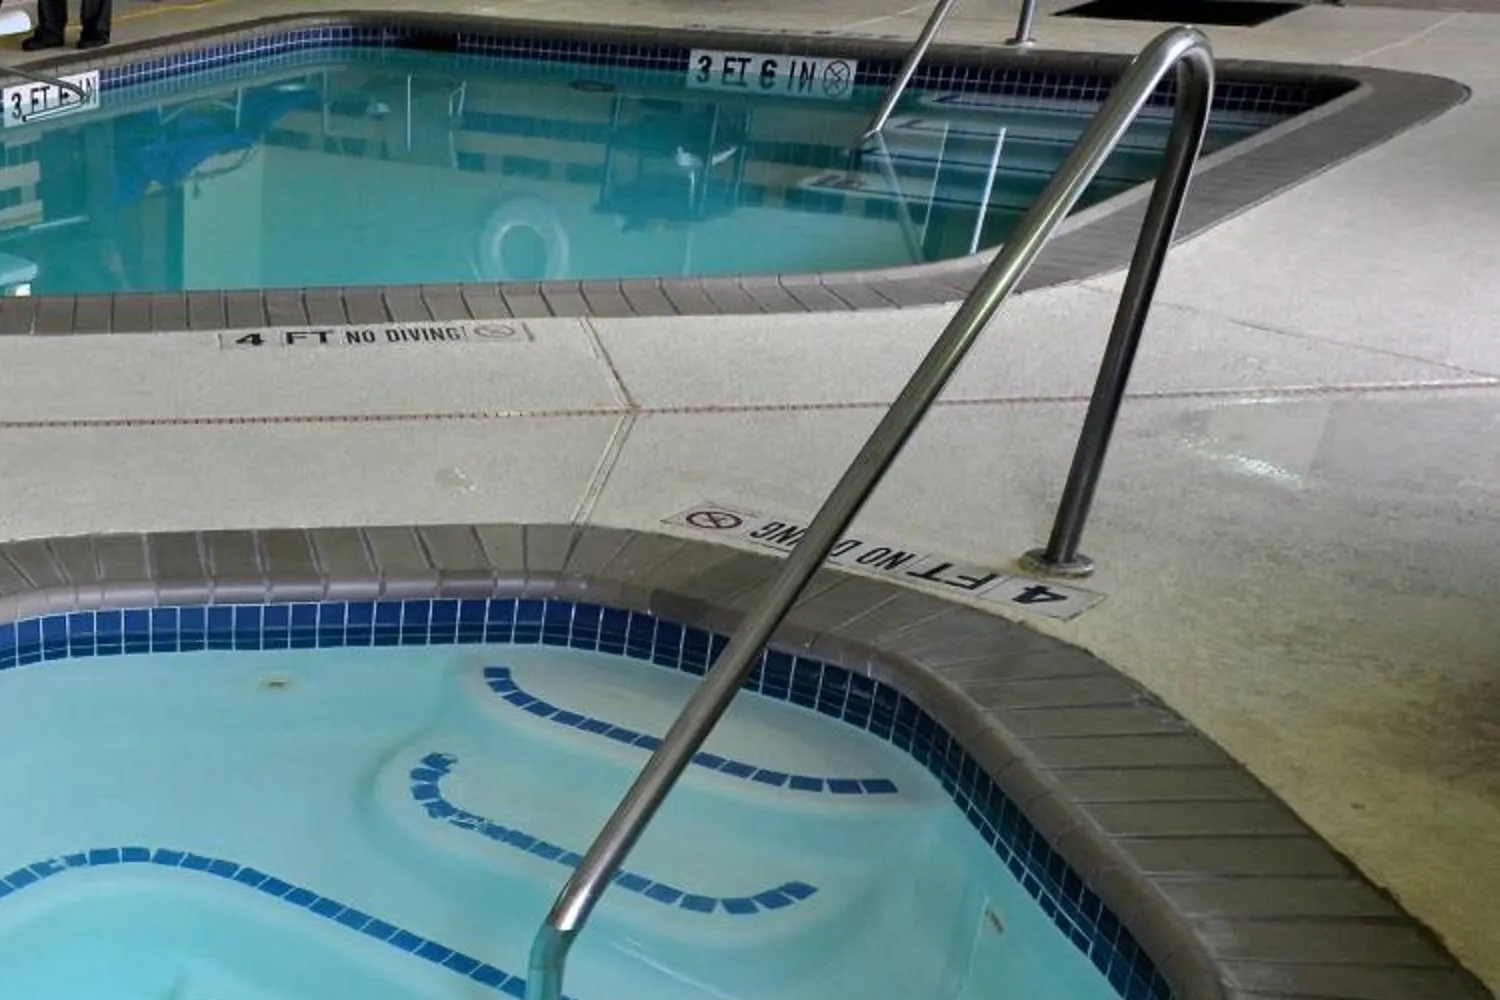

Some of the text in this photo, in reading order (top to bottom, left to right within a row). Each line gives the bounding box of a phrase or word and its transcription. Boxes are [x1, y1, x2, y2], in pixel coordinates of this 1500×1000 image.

[697, 55, 713, 82] 3
[722, 56, 751, 86] FT
[788, 60, 817, 91] IN
[235, 324, 464, 346] 4 FT NO DIVING
[856, 547, 917, 571] NO
[905, 562, 998, 591] FT
[1011, 585, 1068, 604] 4
